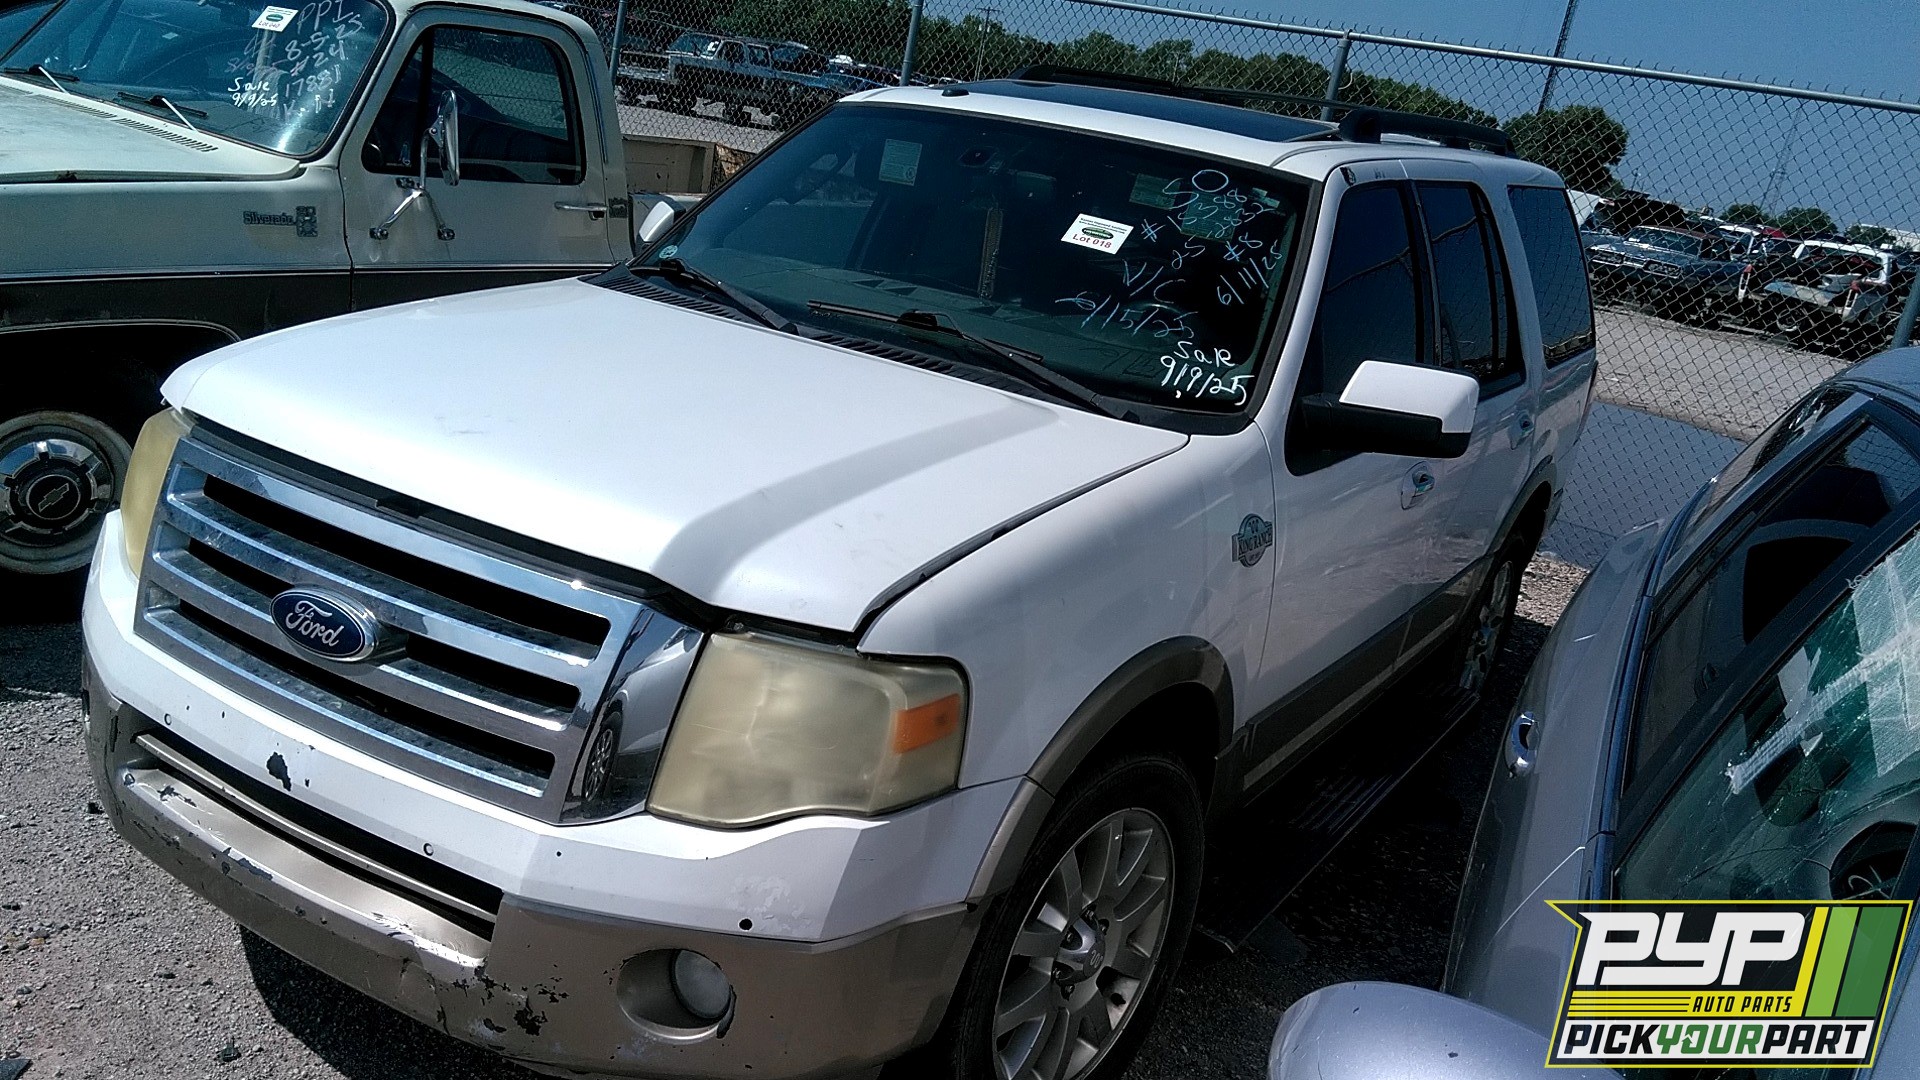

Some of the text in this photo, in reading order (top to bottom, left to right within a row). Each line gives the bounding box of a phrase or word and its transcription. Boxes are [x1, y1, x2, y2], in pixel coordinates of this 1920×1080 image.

[227, 77, 270, 92] Sale
[231, 92, 279, 108] 9/9/25
[243, 210, 294, 227] Silverado
[1072, 233, 1091, 243] Lot
[1092, 238, 1112, 249] 018
[1160, 355, 1256, 406] 9/9/25
[285, 600, 345, 647] Ford
